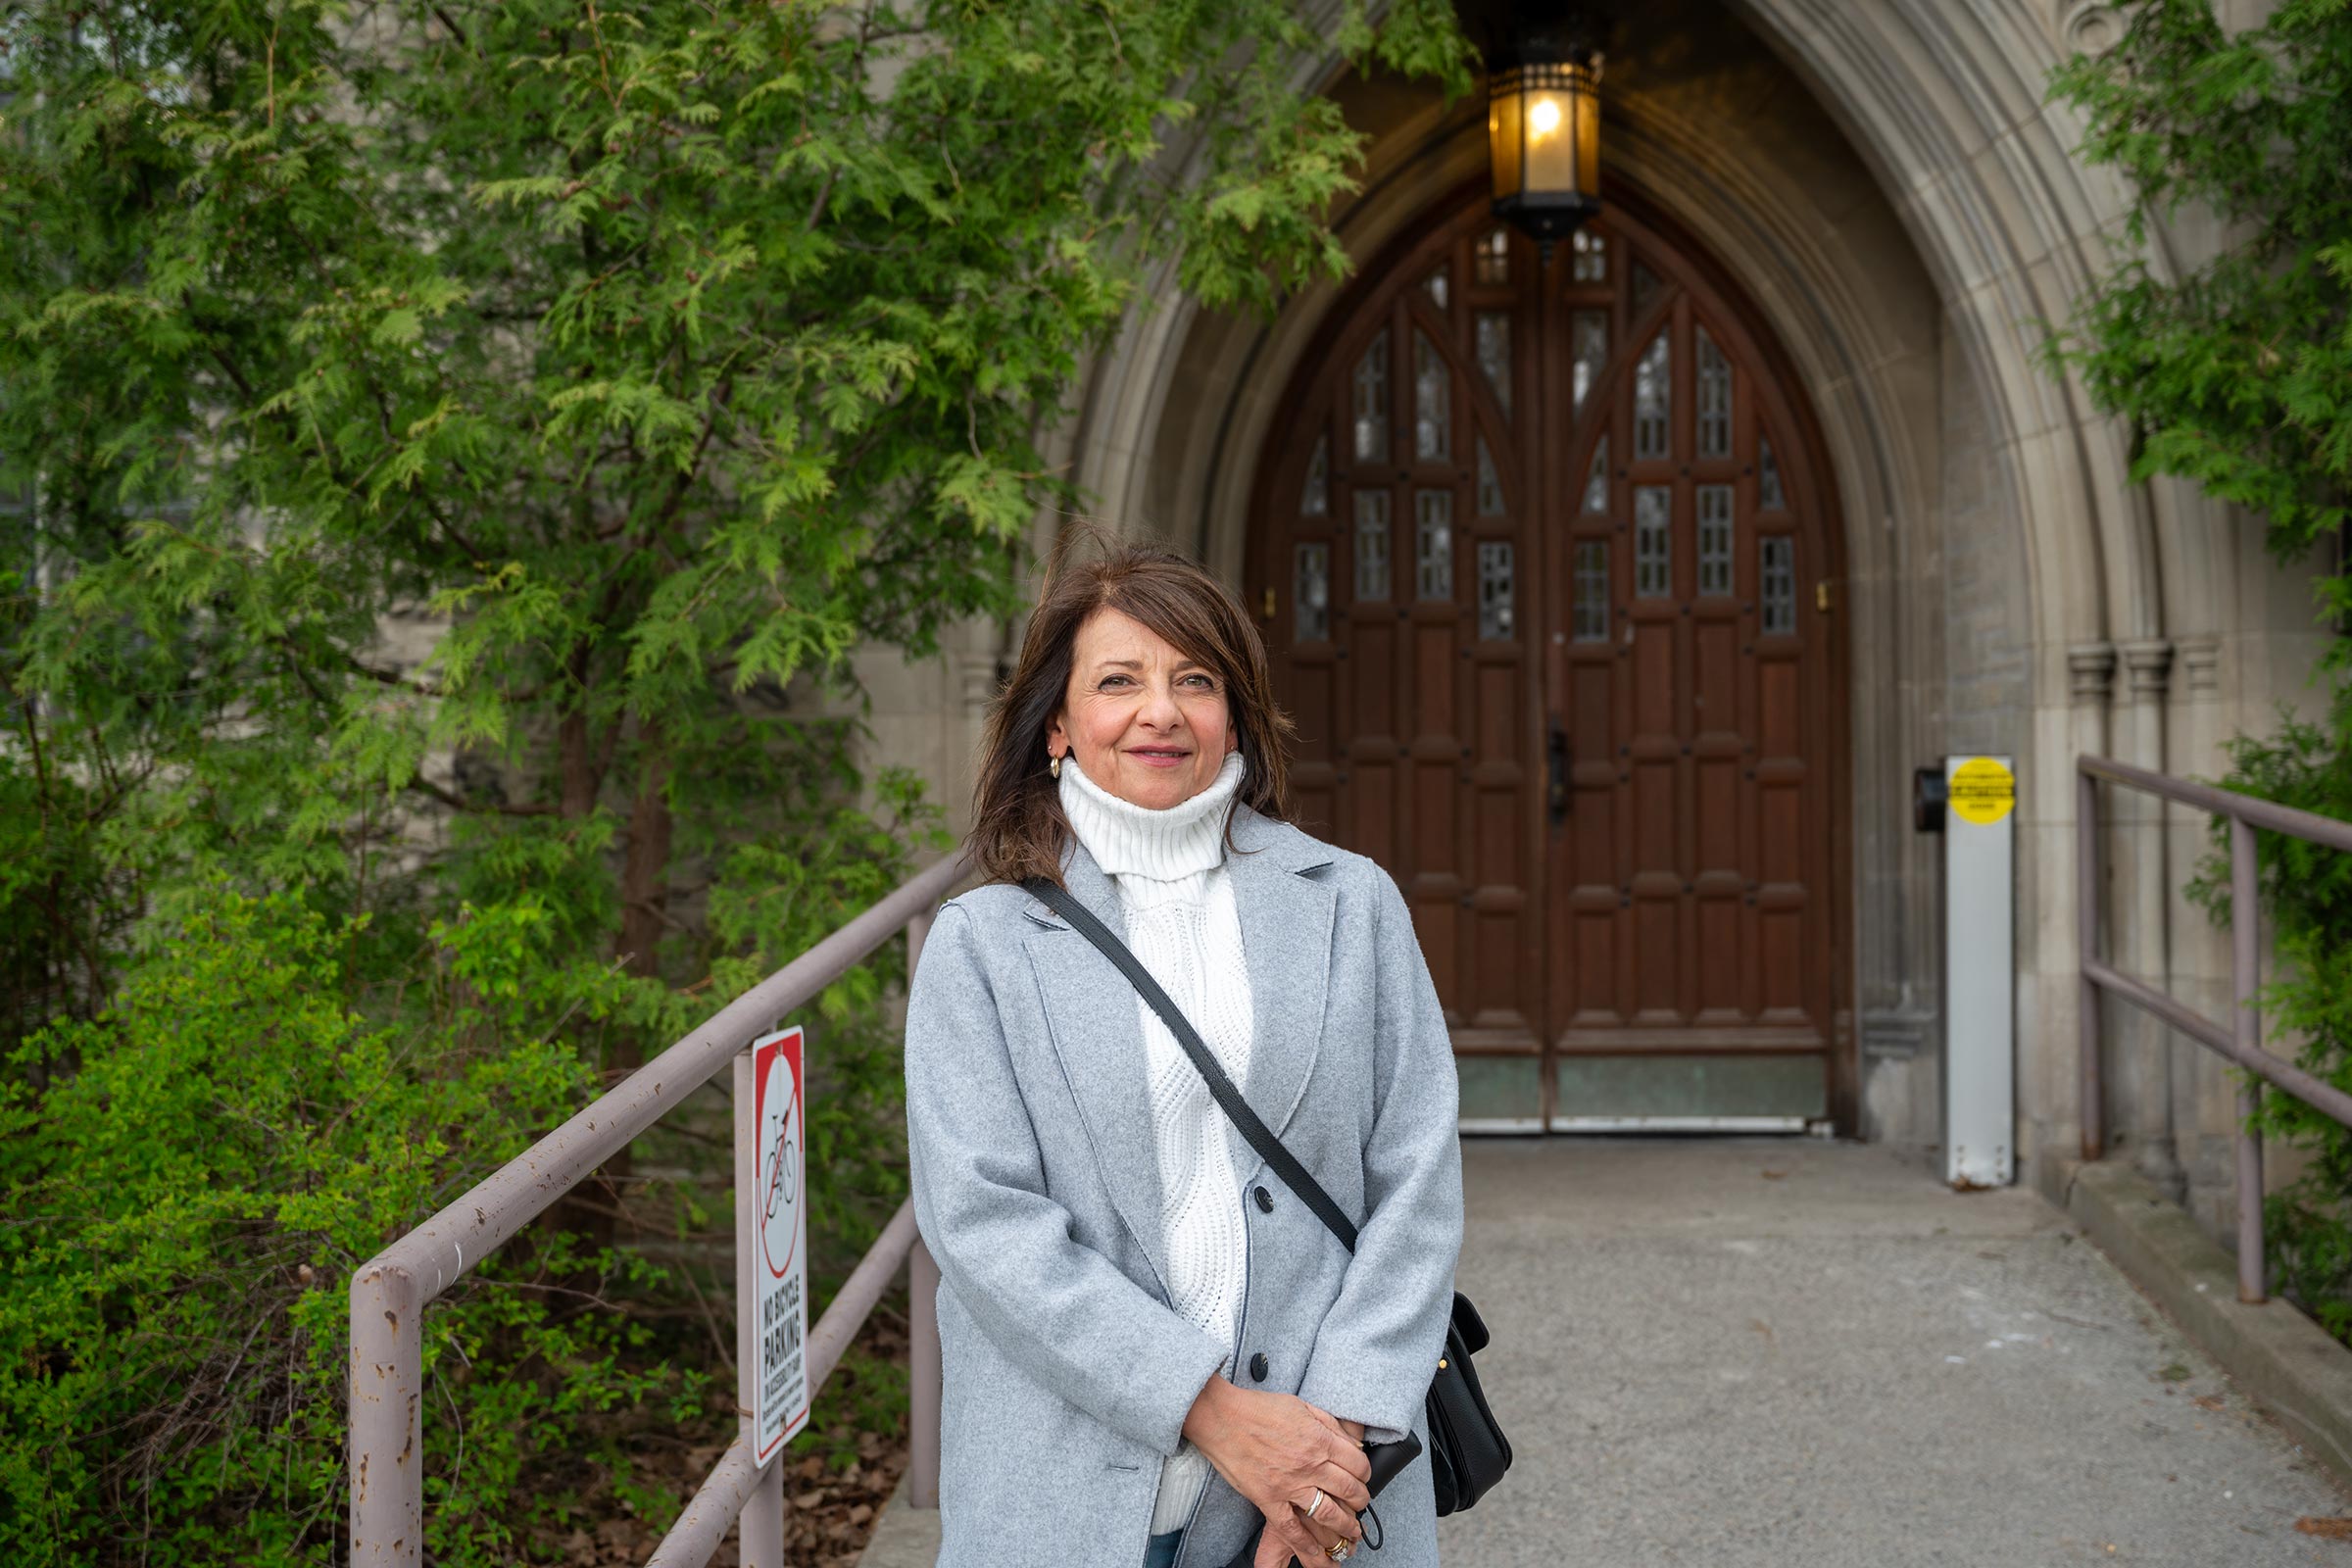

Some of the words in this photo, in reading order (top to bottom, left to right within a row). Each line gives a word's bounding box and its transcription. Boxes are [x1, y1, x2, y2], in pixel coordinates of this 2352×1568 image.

[764, 1296, 773, 1330] NO
[775, 1274, 799, 1322] BICYCLE
[764, 1308, 800, 1378] PARKING
